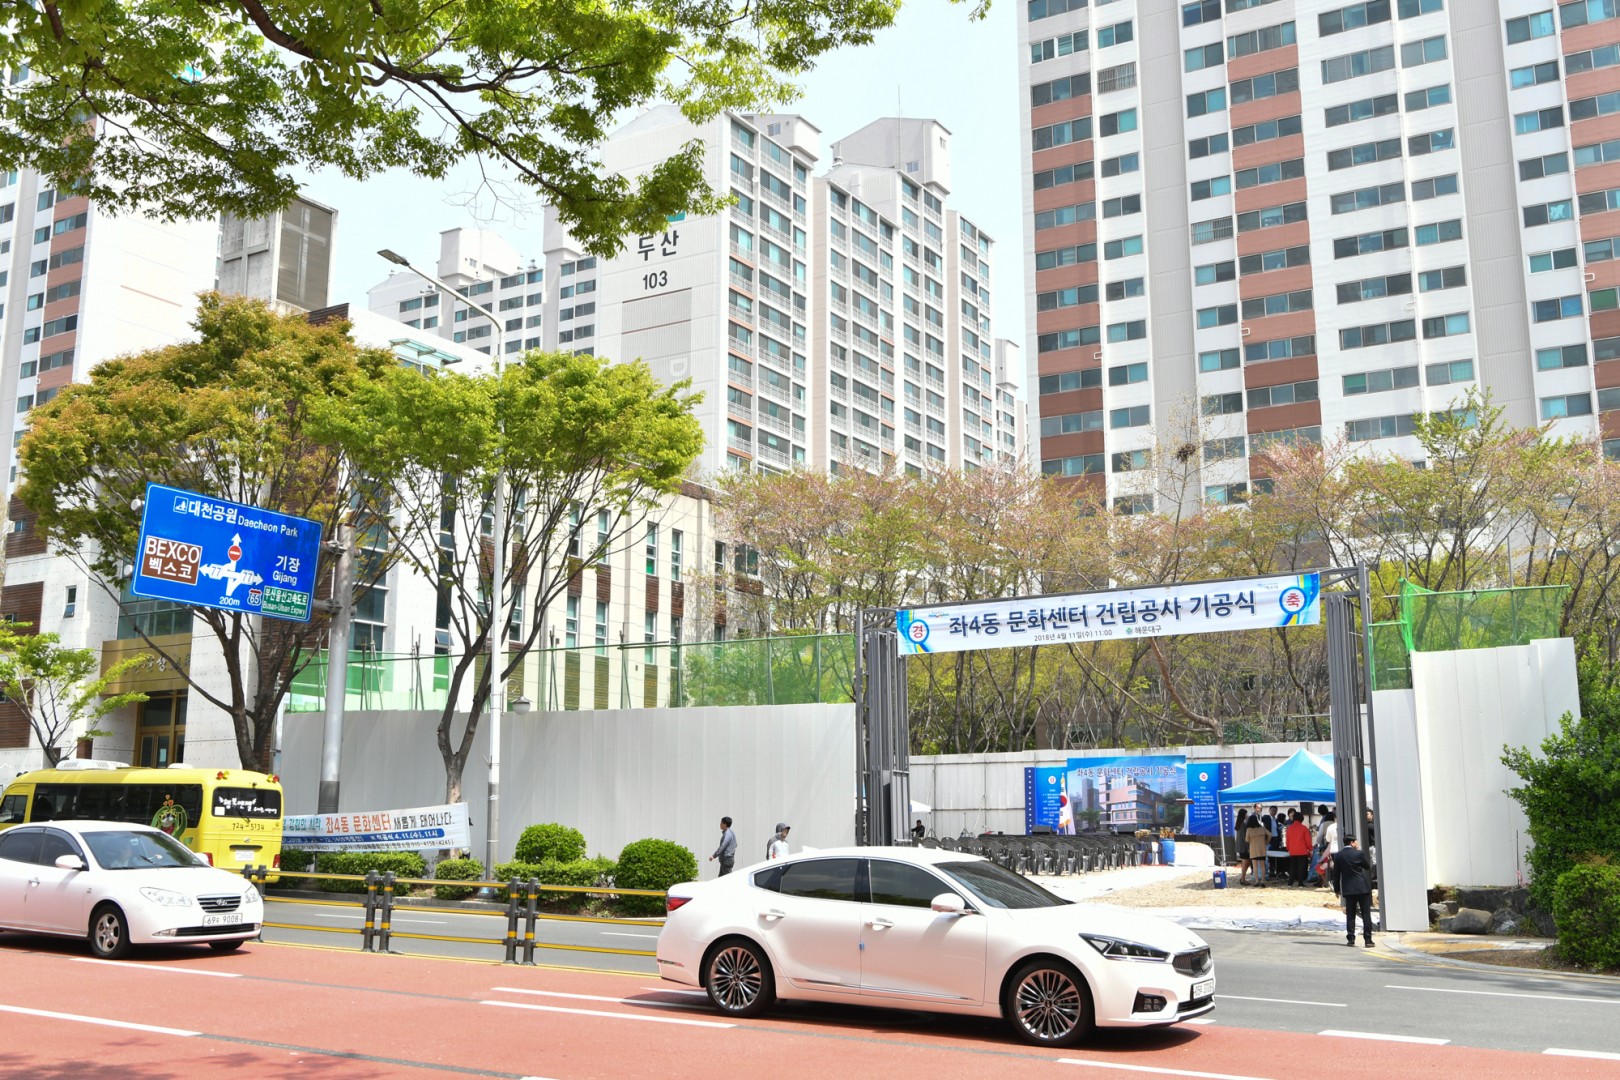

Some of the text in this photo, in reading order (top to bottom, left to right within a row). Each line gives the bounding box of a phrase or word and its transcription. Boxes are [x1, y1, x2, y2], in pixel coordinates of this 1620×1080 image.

[637, 230, 679, 261] 두산
[642, 270, 668, 290] 103
[189, 500, 298, 537] 대천공원 Daecheon Park
[146, 537, 200, 564] BEXCO
[149, 557, 192, 579] 벡스코
[275, 555, 300, 572] 기장
[211, 566, 222, 578] 77
[242, 571, 253, 583] 77
[273, 570, 297, 586] Gijang
[219, 596, 240, 607] 200m
[249, 593, 259, 604] 65
[264, 588, 308, 605] 부산울산고속도로
[1286, 592, 1301, 608] 축
[263, 598, 290, 612] Busan-Ulsan
[949, 590, 1256, 637] 좌4동 문화센터 건립공사 기공식
[912, 624, 924, 639] 경
[1034, 629, 1113, 642] 2018년 4월 11일(수) 11:00
[1134, 625, 1162, 635] 해운대구
[326, 815, 350, 834] 좌4동
[353, 813, 392, 832] 문화센터
[393, 814, 417, 830] 새롭게
[223, 915, 239, 924] 9008
